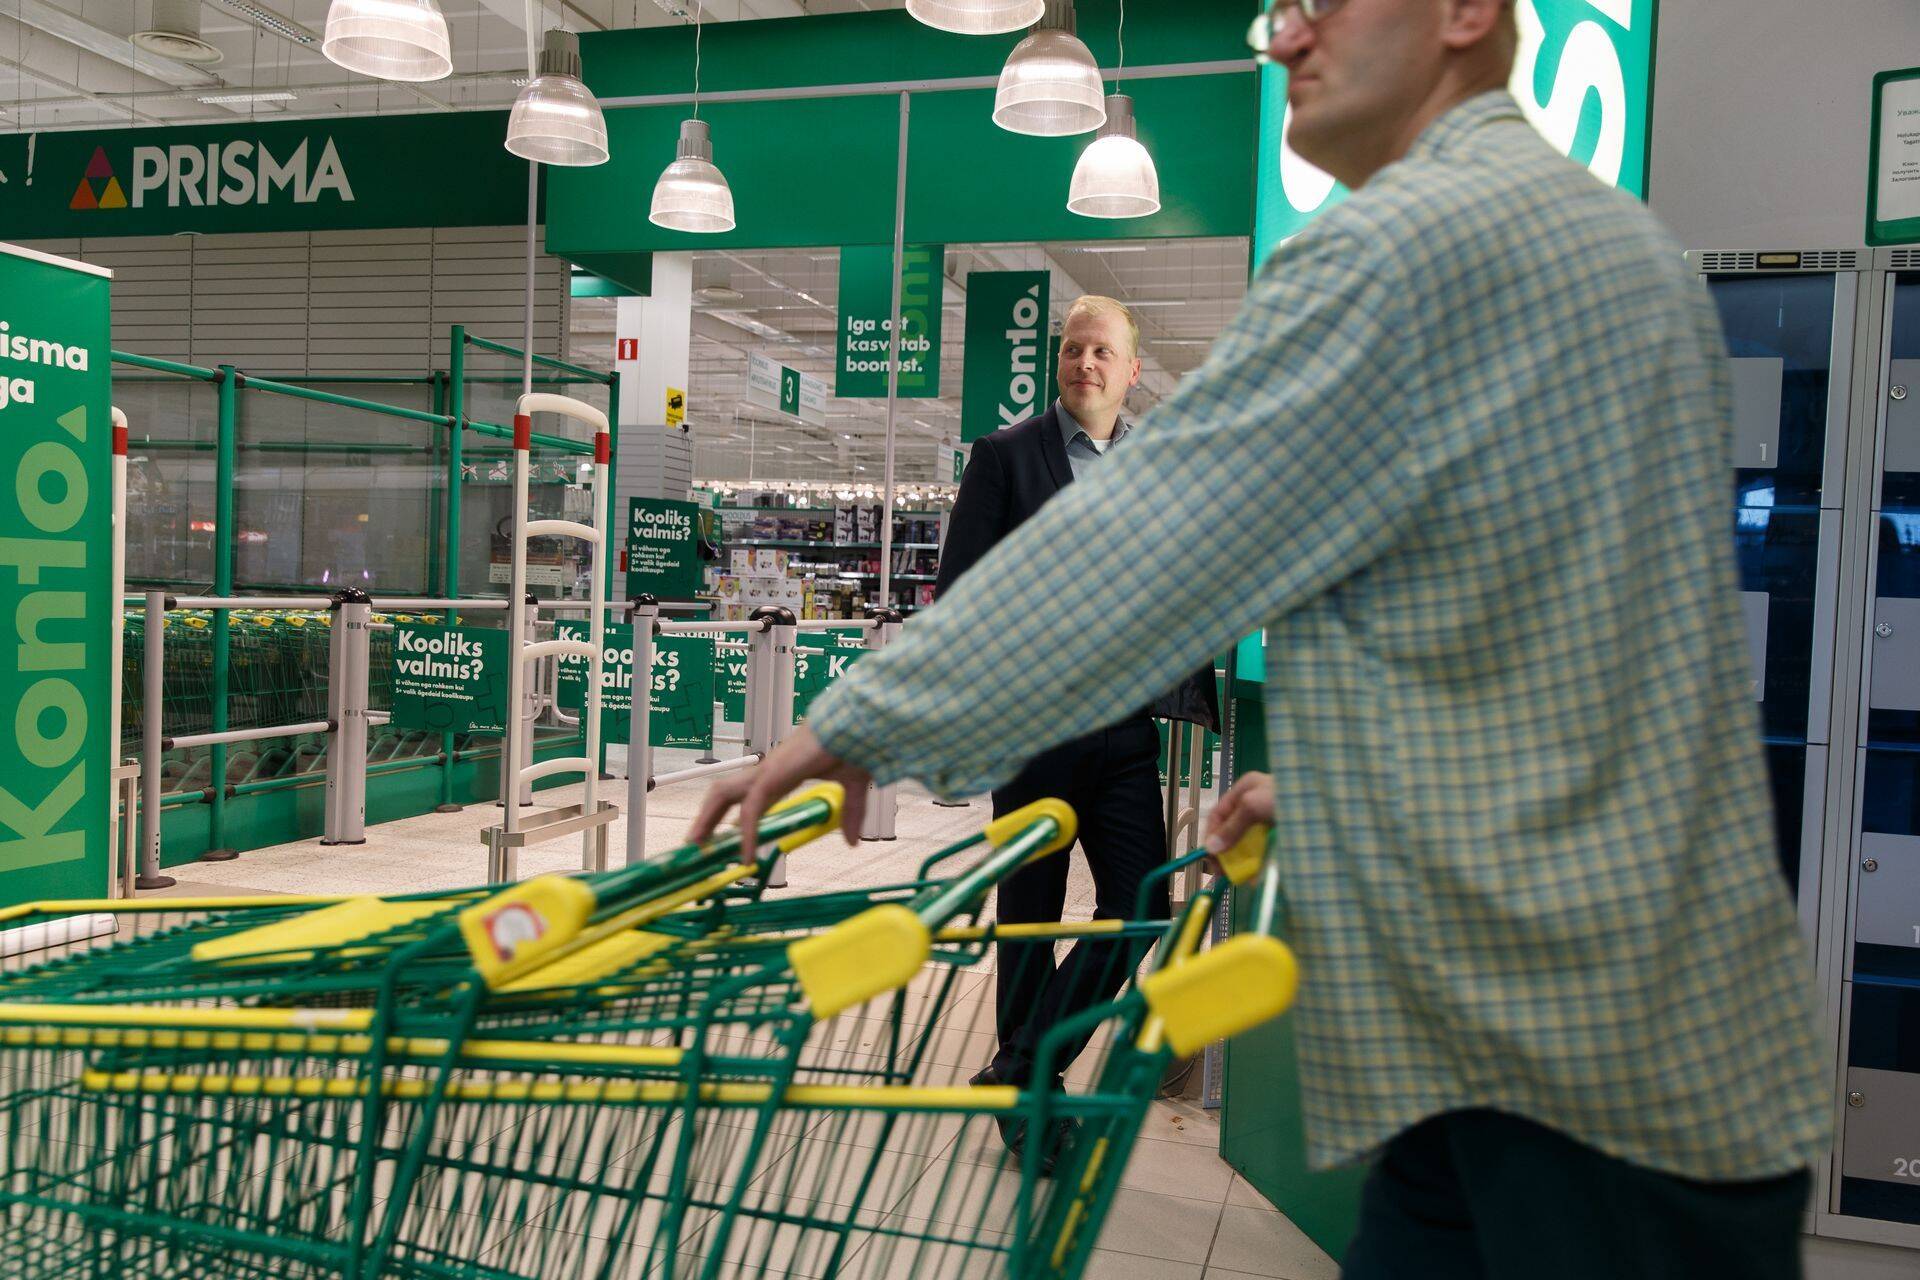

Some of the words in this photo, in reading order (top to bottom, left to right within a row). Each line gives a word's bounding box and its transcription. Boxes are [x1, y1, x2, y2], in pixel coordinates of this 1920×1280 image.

[132, 135, 355, 208] PRISMA
[847, 315, 876, 335] Iga
[881, 316, 909, 331] ot
[846, 334, 931, 351] kasvtab
[998, 298, 1040, 430] Konto
[785, 376, 794, 404] 3
[1759, 443, 1768, 462] 1
[634, 508, 690, 526] Kooliks
[633, 523, 691, 541] valmis?
[0, 441, 89, 873] Konto
[398, 630, 483, 657] Kooliks
[587, 641, 680, 667] ooks
[396, 653, 484, 681] valmis?
[585, 664, 681, 692] als?
